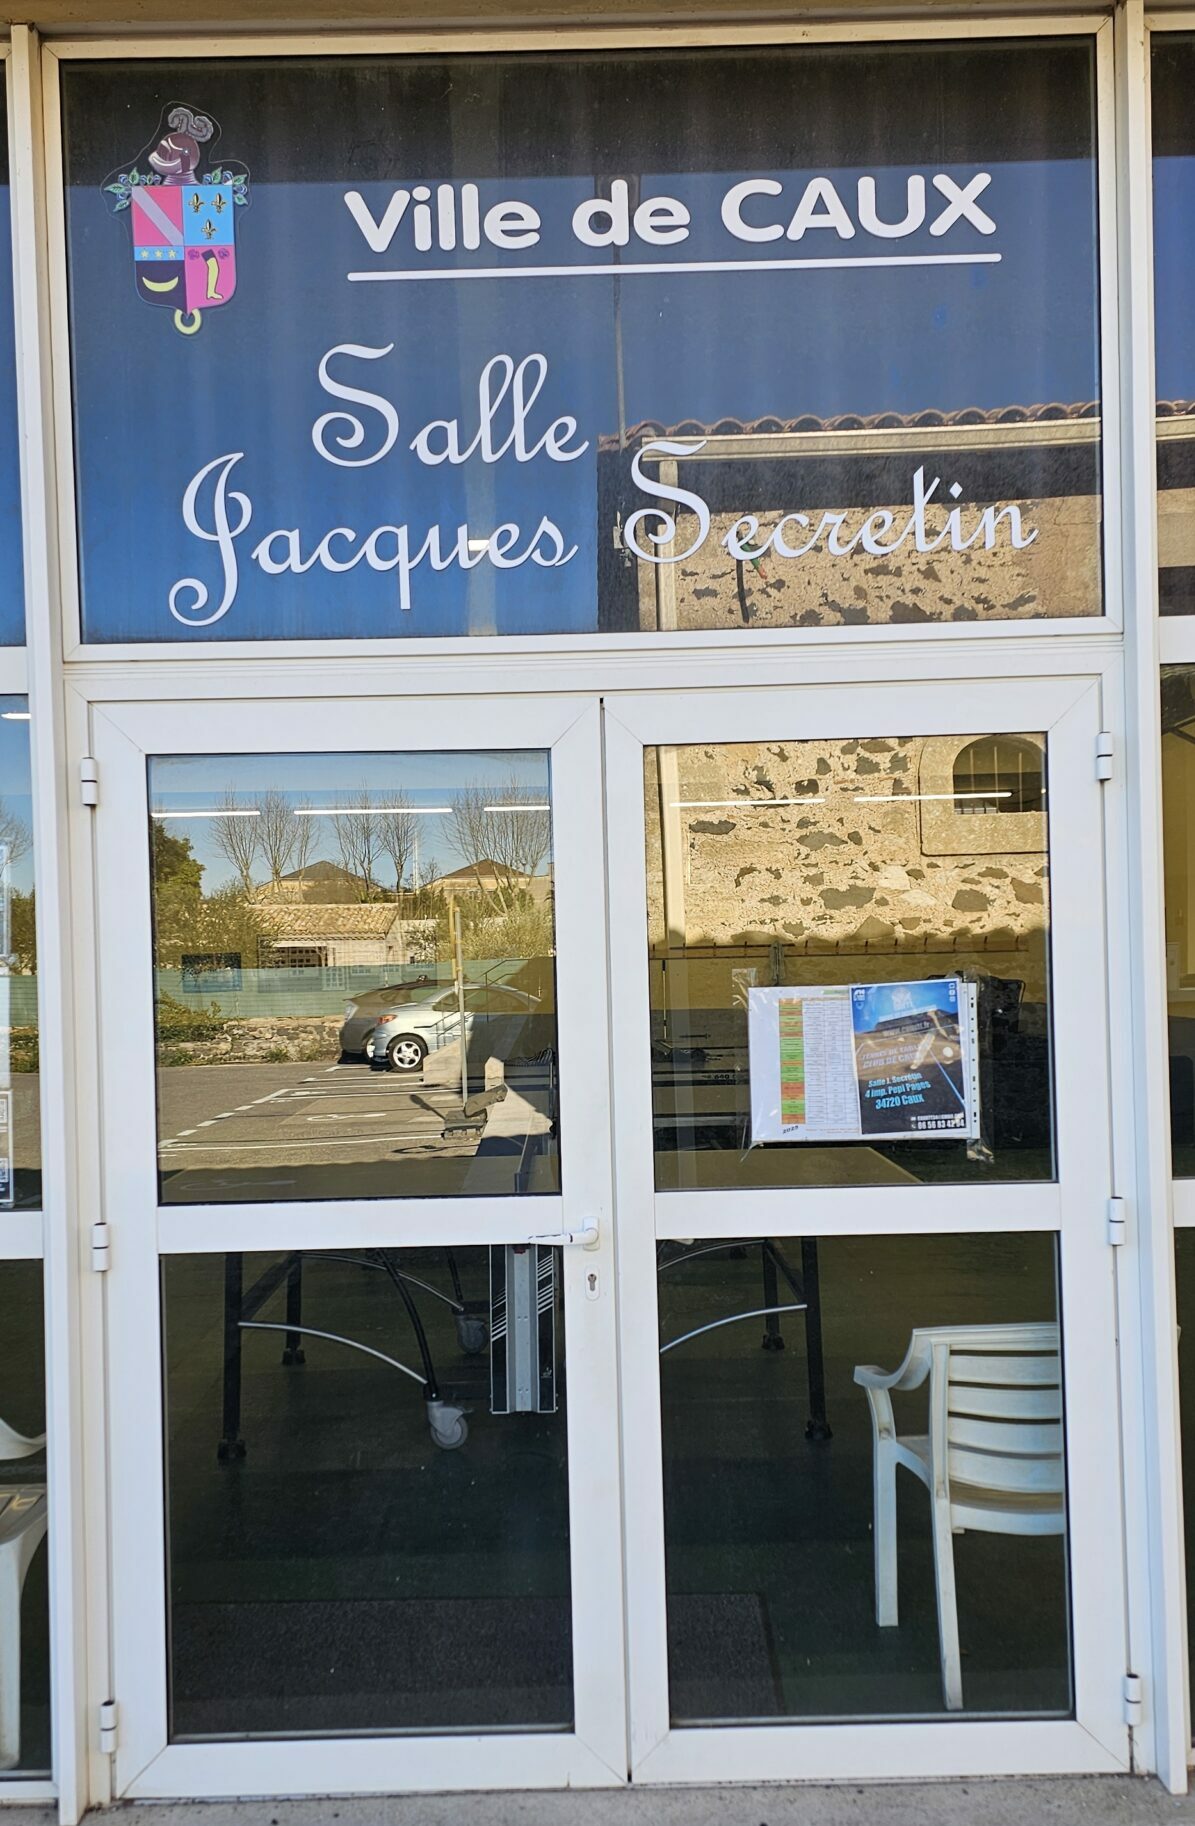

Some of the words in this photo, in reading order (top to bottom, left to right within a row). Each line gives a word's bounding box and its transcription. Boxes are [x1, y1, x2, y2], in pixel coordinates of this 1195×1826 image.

[344, 183, 541, 253] Ville
[572, 179, 691, 247] de
[721, 172, 997, 243] CAUX
[311, 343, 589, 468] Salle
[168, 452, 579, 628] Jacques
[624, 439, 1039, 564] Secretin
[865, 1089, 870, 1098] 4
[875, 1097, 901, 1110] 34720
[902, 1093, 925, 1105] Caux
